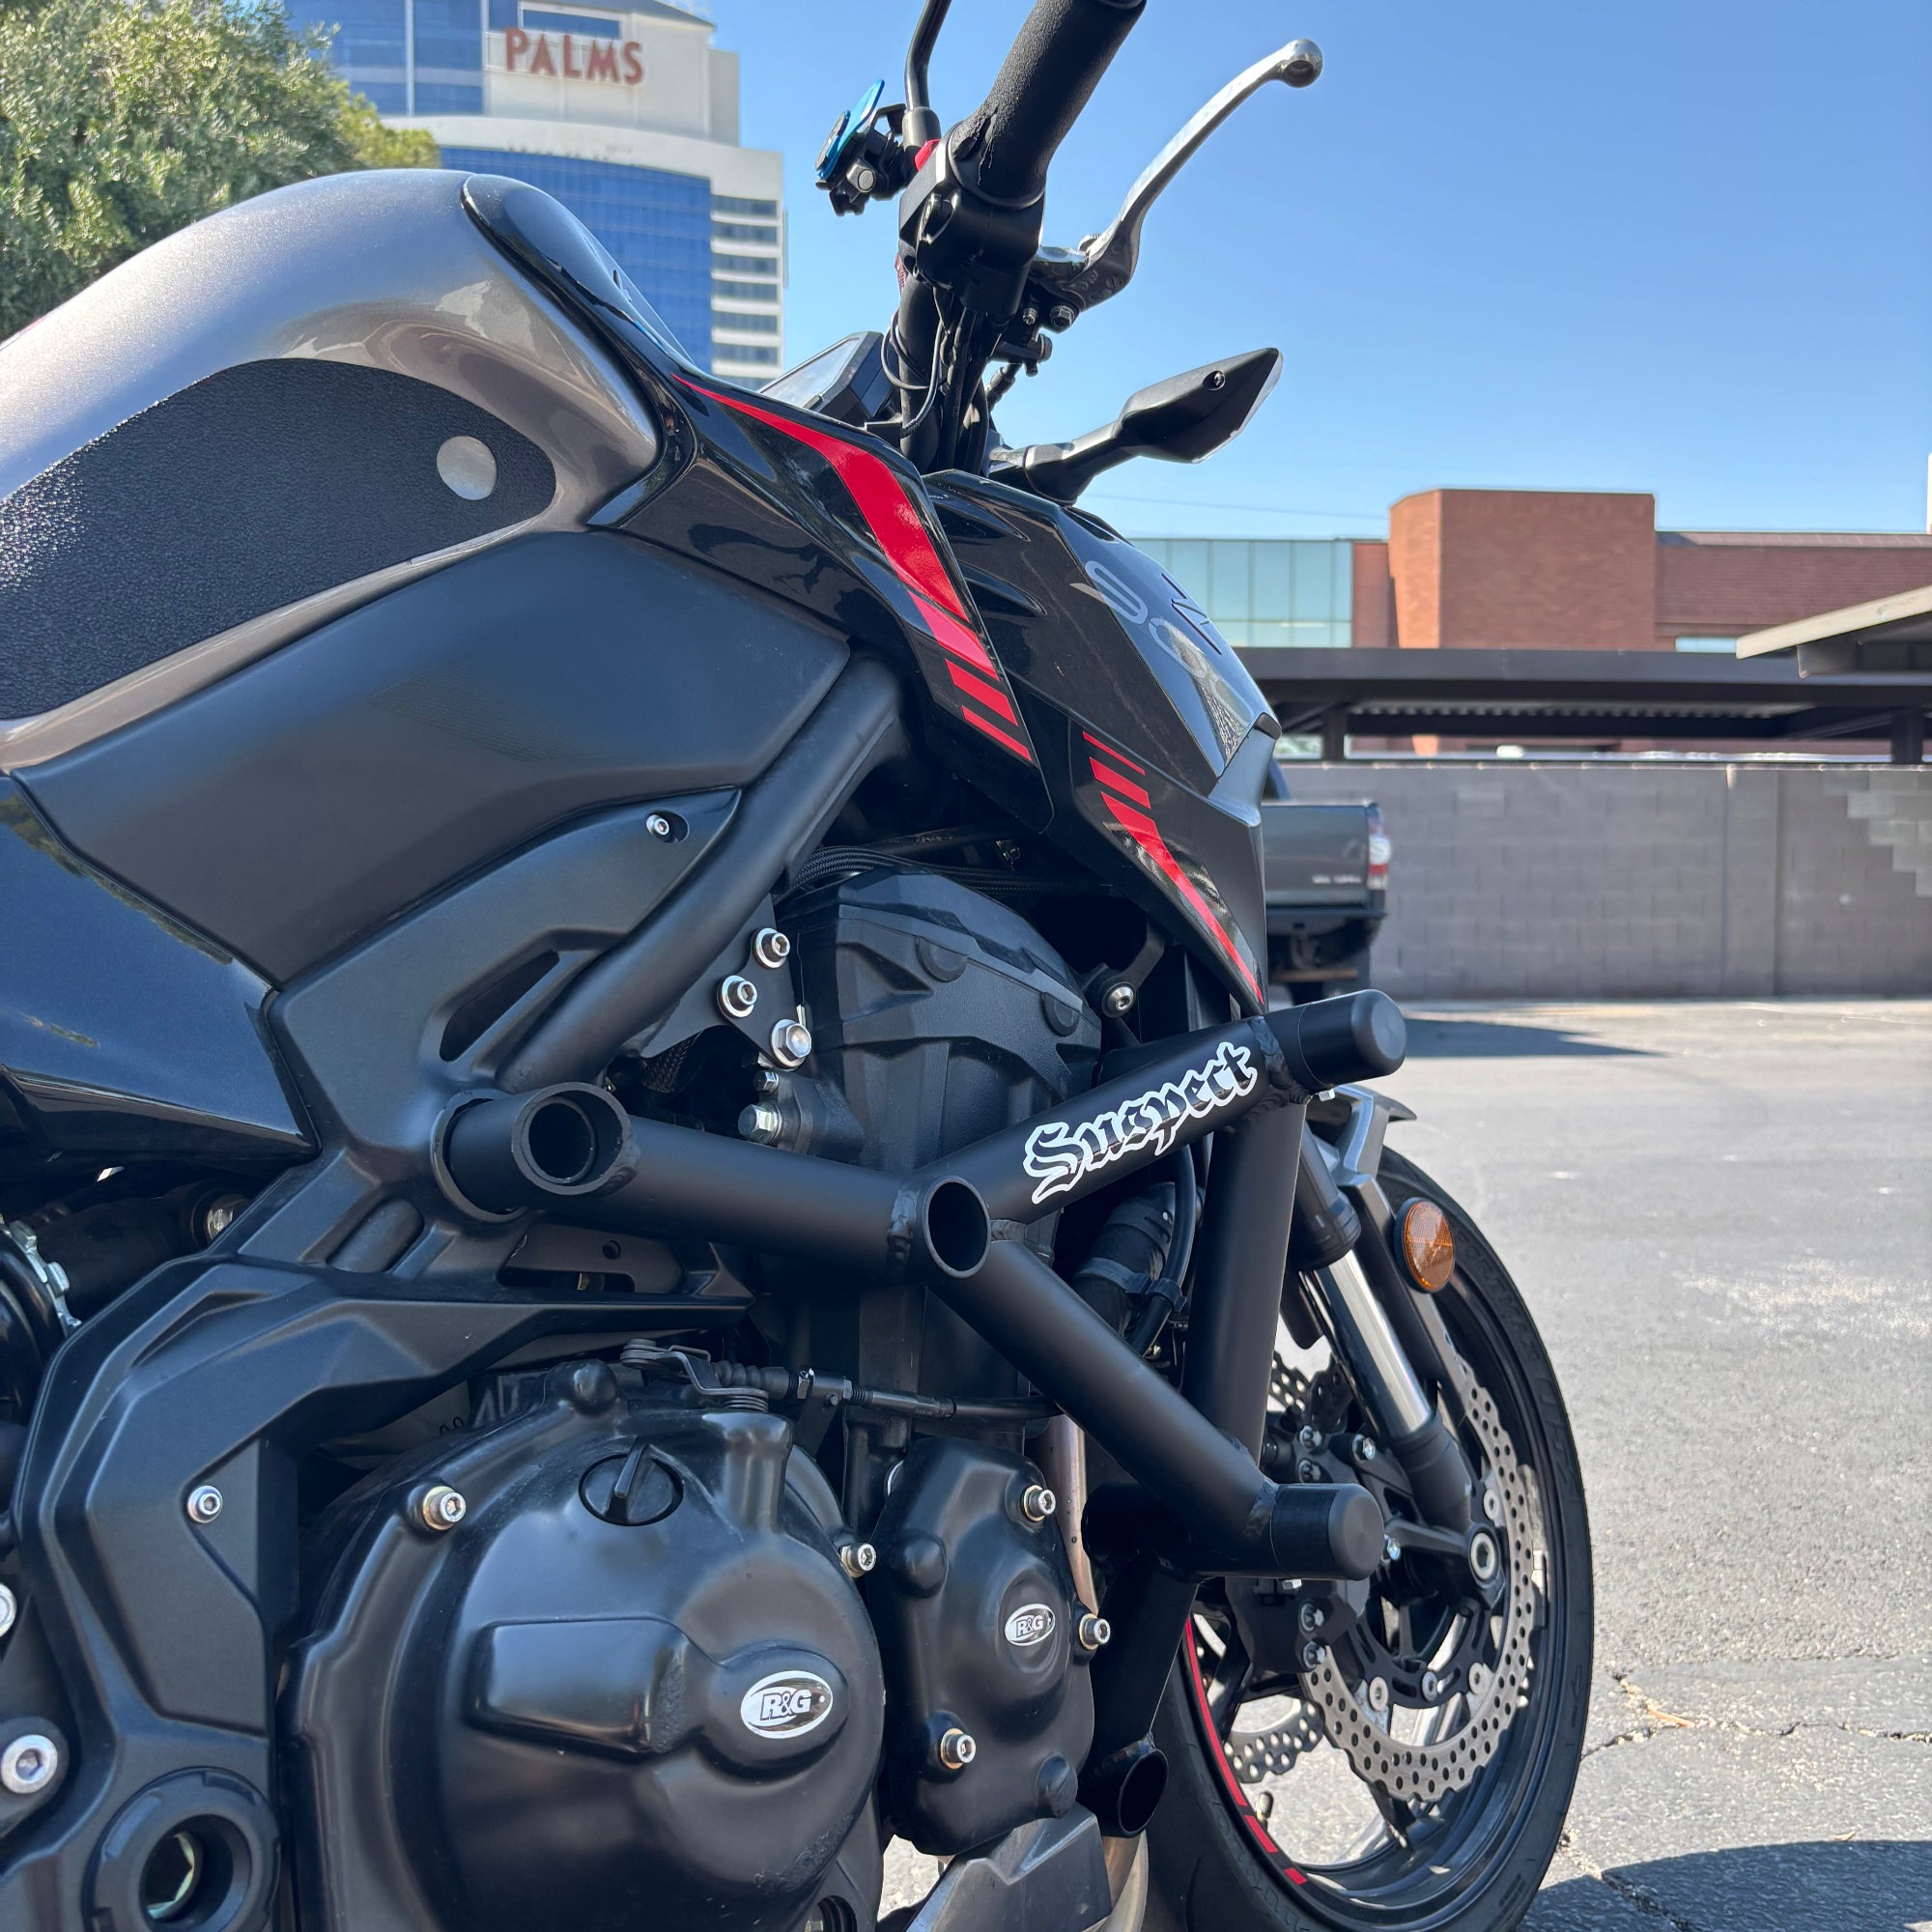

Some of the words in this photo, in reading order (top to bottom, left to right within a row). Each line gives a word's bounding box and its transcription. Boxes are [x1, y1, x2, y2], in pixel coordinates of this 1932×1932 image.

[504, 27, 643, 85] PALMS
[1022, 1041, 1258, 1205] Suspect
[1015, 1614, 1044, 1638] R&G
[759, 1689, 811, 1721] R&G
